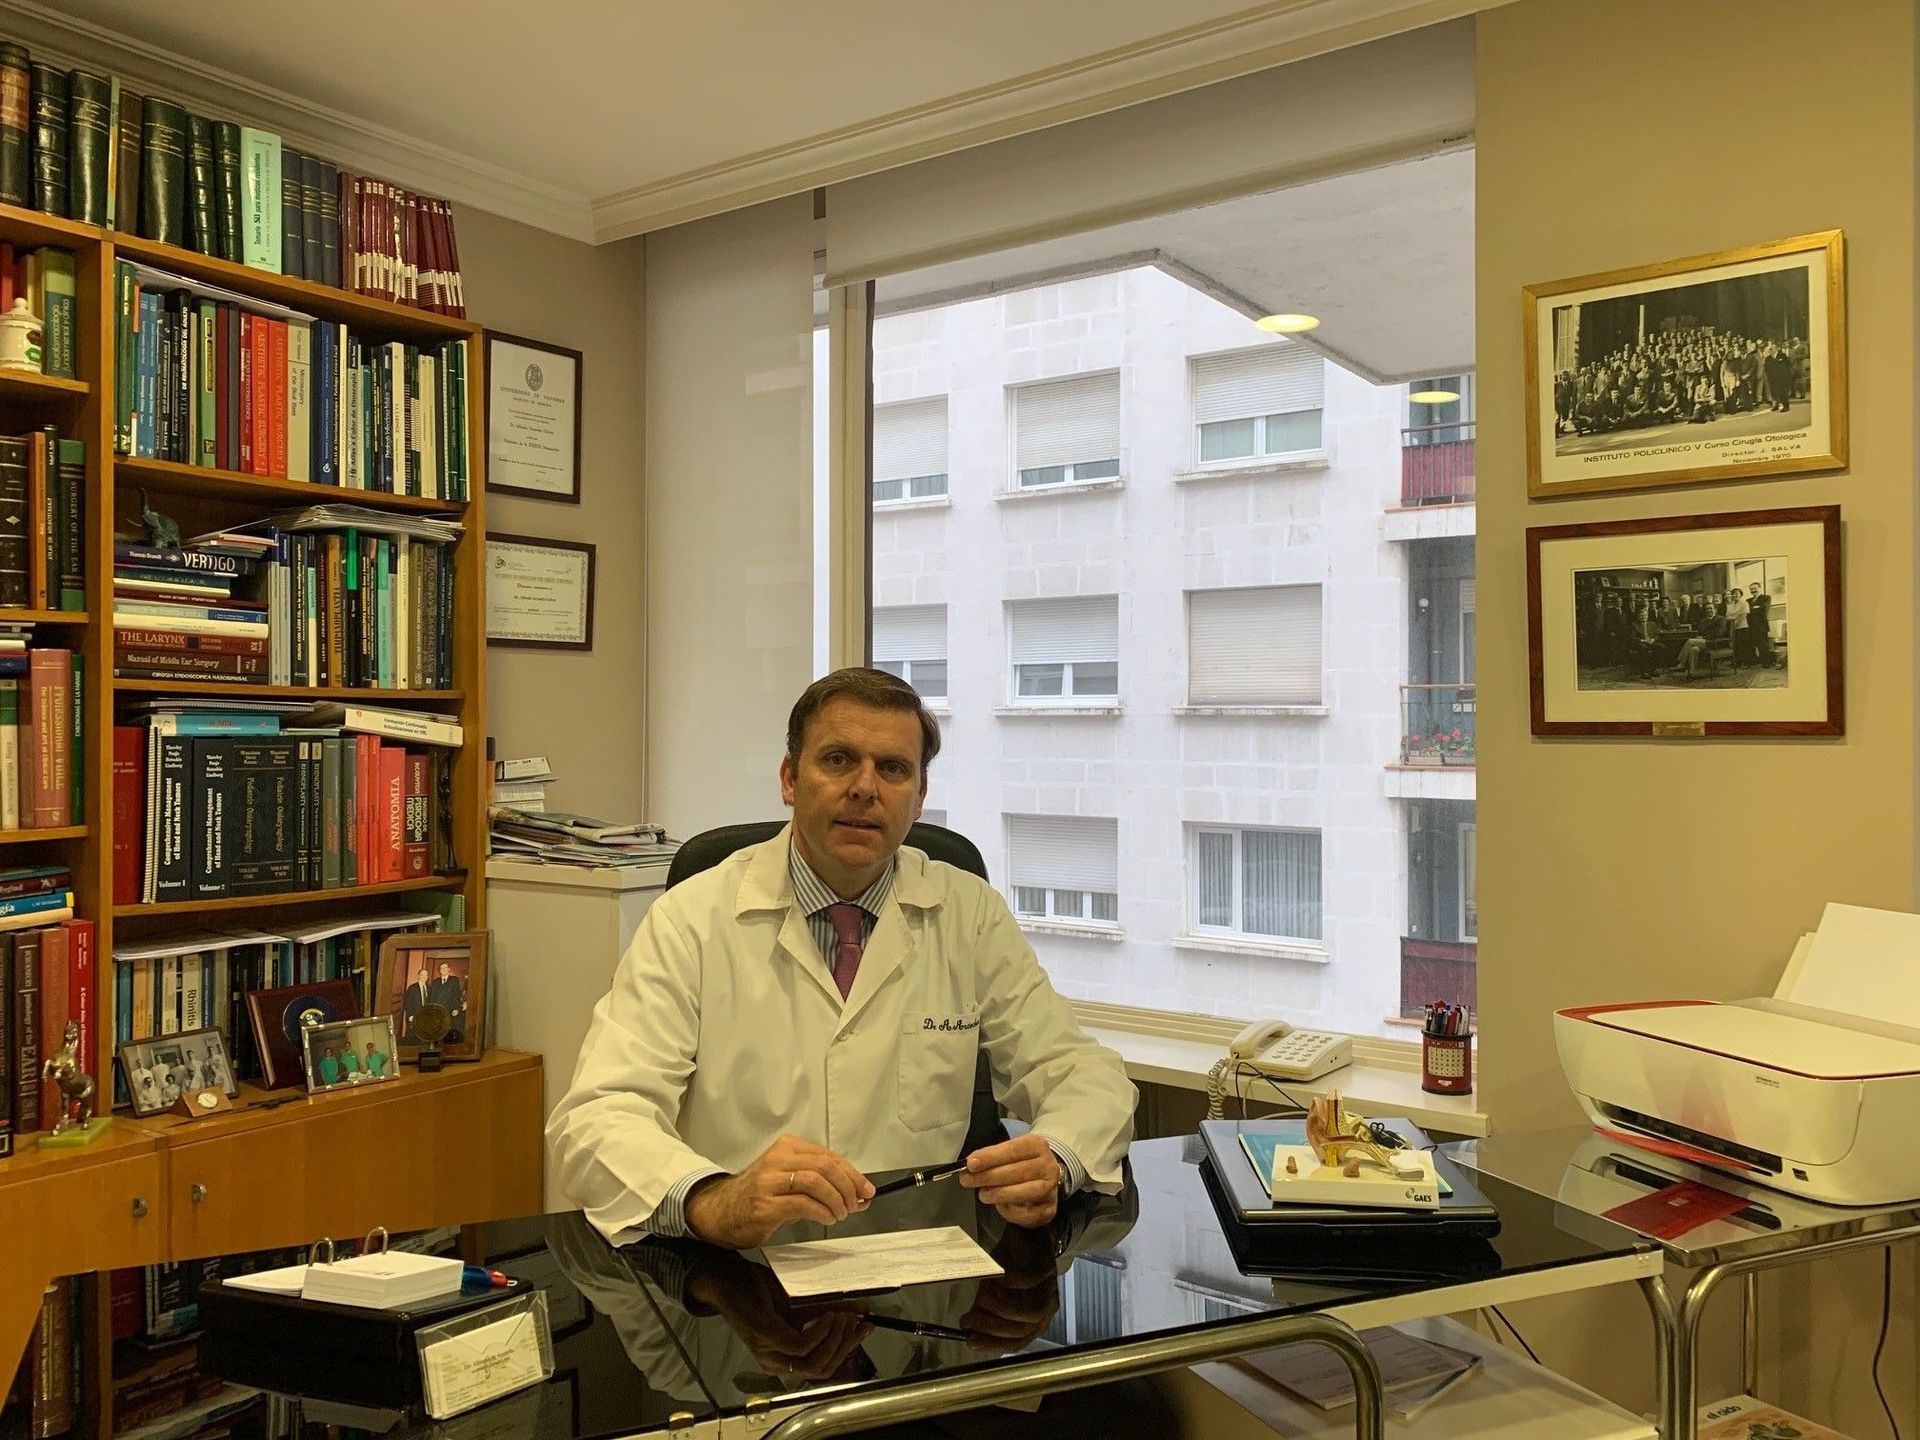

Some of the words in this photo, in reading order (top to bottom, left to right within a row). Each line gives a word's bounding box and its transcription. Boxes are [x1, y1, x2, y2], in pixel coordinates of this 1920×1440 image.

[1584, 451, 1630, 463] INSTITUTO
[1633, 445, 1691, 457] POLICLINICO
[1704, 441, 1730, 449] Curso
[71, 523, 78, 534] OF
[183, 552, 235, 572] VERTIGO
[120, 632, 141, 642] THE
[145, 633, 185, 644] LARYNX
[128, 655, 150, 664] Manual
[194, 659, 219, 668] Surgery
[391, 776, 400, 851] ANATOMIA
[164, 819, 172, 865] Comprehensive
[205, 828, 213, 873] Comprehensive
[187, 989, 197, 1027] Rhinitis
[21, 1045, 36, 1079] EAR
